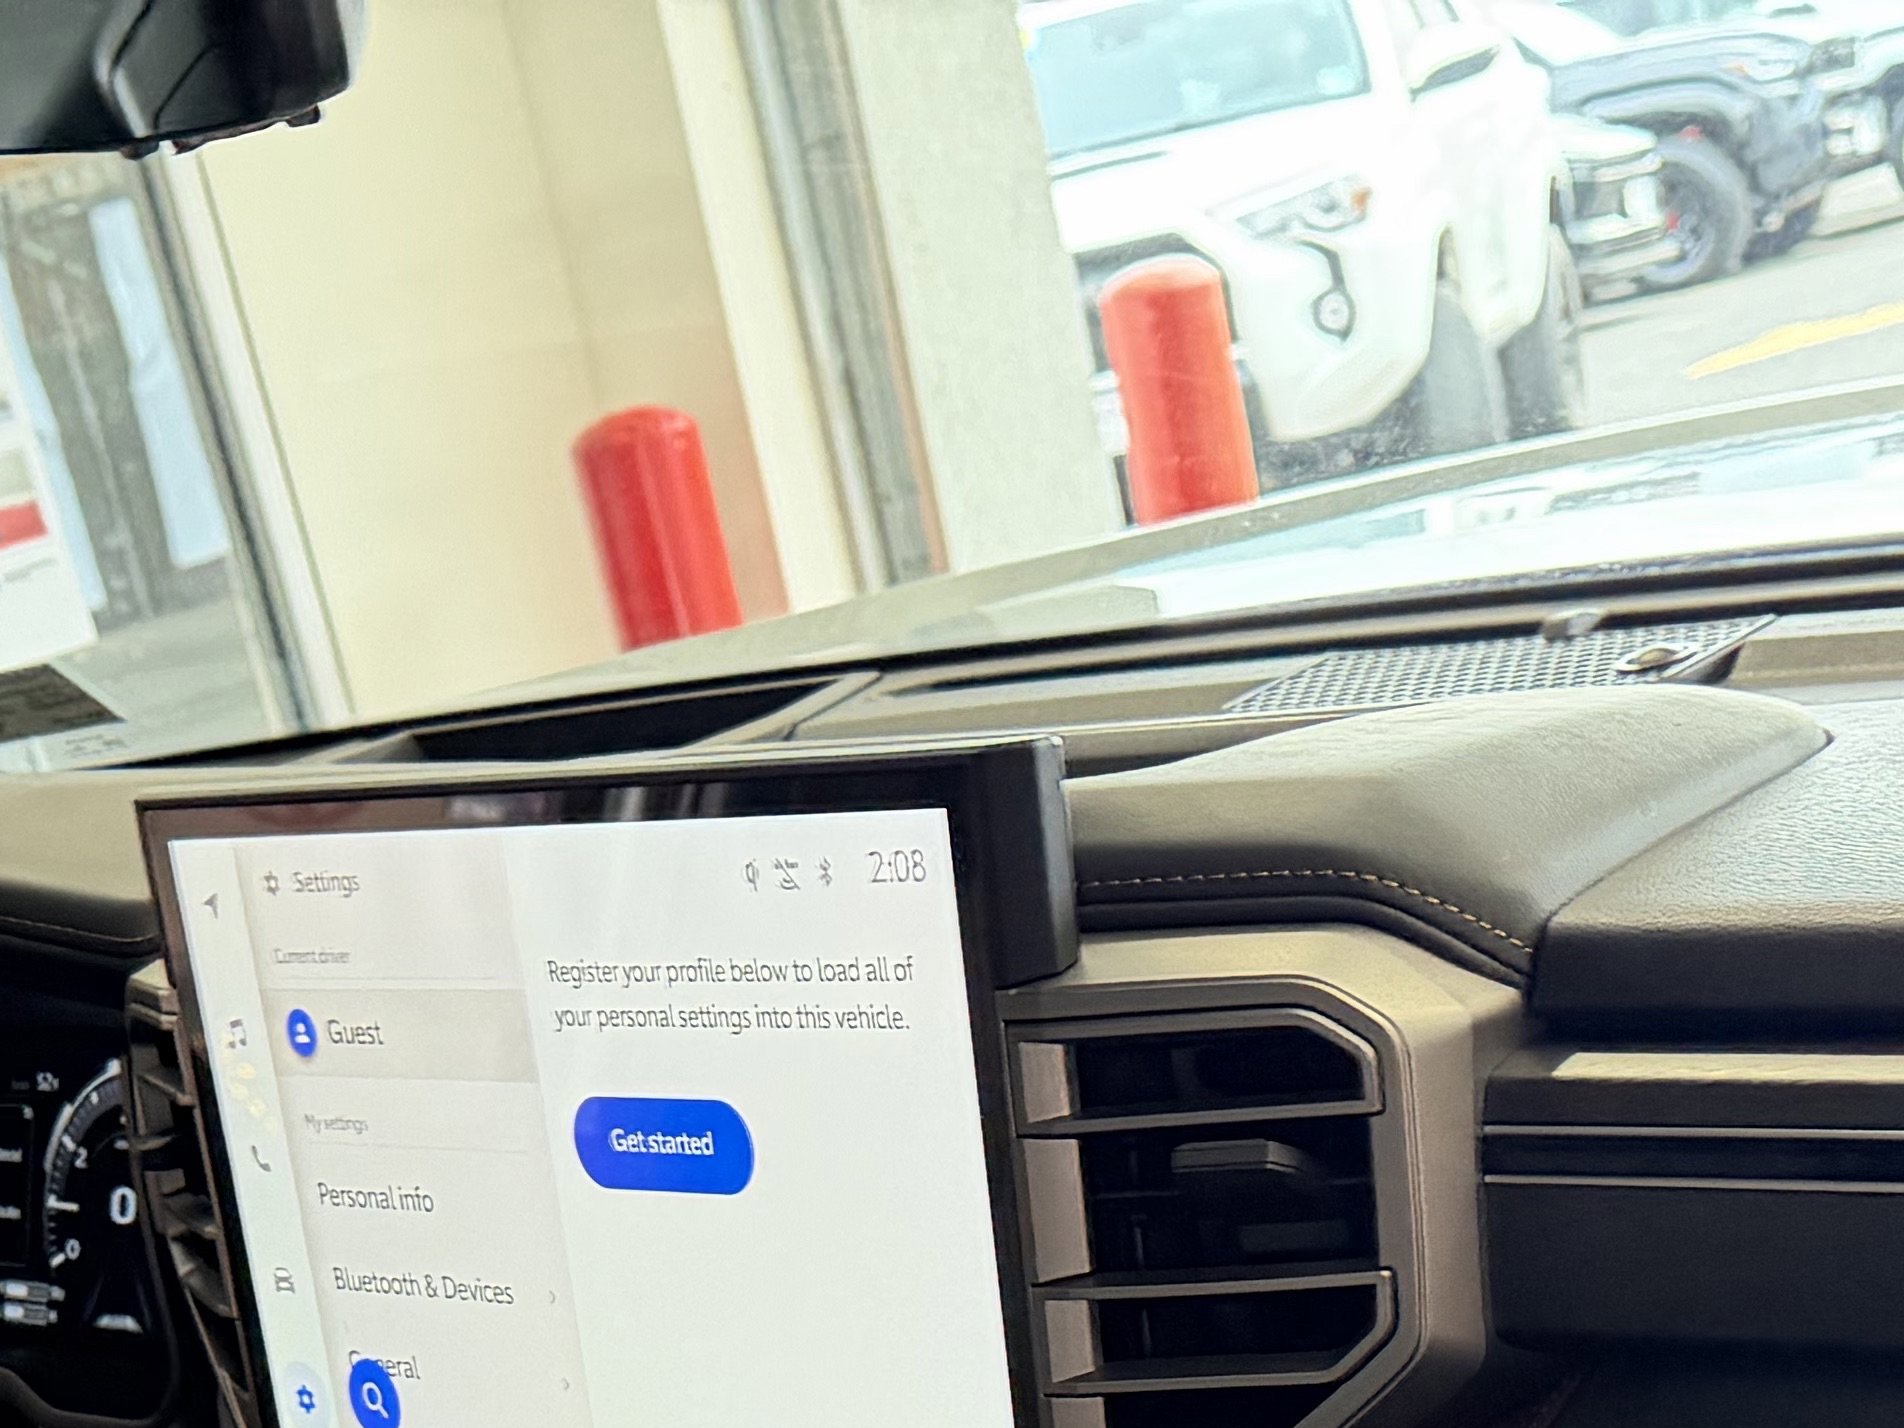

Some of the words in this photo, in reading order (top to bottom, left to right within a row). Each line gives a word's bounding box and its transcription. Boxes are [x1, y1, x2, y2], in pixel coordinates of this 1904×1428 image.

[867, 848, 928, 884] 2:08
[291, 869, 361, 898] Settings
[547, 957, 619, 990] Register
[623, 963, 662, 990] your
[666, 956, 726, 988] profile
[730, 956, 789, 983] below
[792, 962, 814, 983] to
[817, 956, 861, 983] load
[866, 955, 890, 983] all
[893, 954, 916, 982] of
[327, 1018, 385, 1046] Guest
[553, 1008, 593, 1033] your
[597, 1003, 674, 1033] personal
[679, 1006, 752, 1036] settings
[755, 1004, 793, 1031] into
[796, 1003, 832, 1030] this
[834, 1003, 911, 1031] vehicle.
[609, 1126, 645, 1154] Get
[646, 1130, 715, 1157] started
[108, 1185, 138, 1226] 0
[317, 1181, 398, 1211] Personal
[399, 1186, 436, 1213] info
[64, 1238, 82, 1261] 0
[332, 1266, 422, 1297] Bluetooth
[424, 1274, 441, 1298] &
[442, 1275, 515, 1306] Devices
